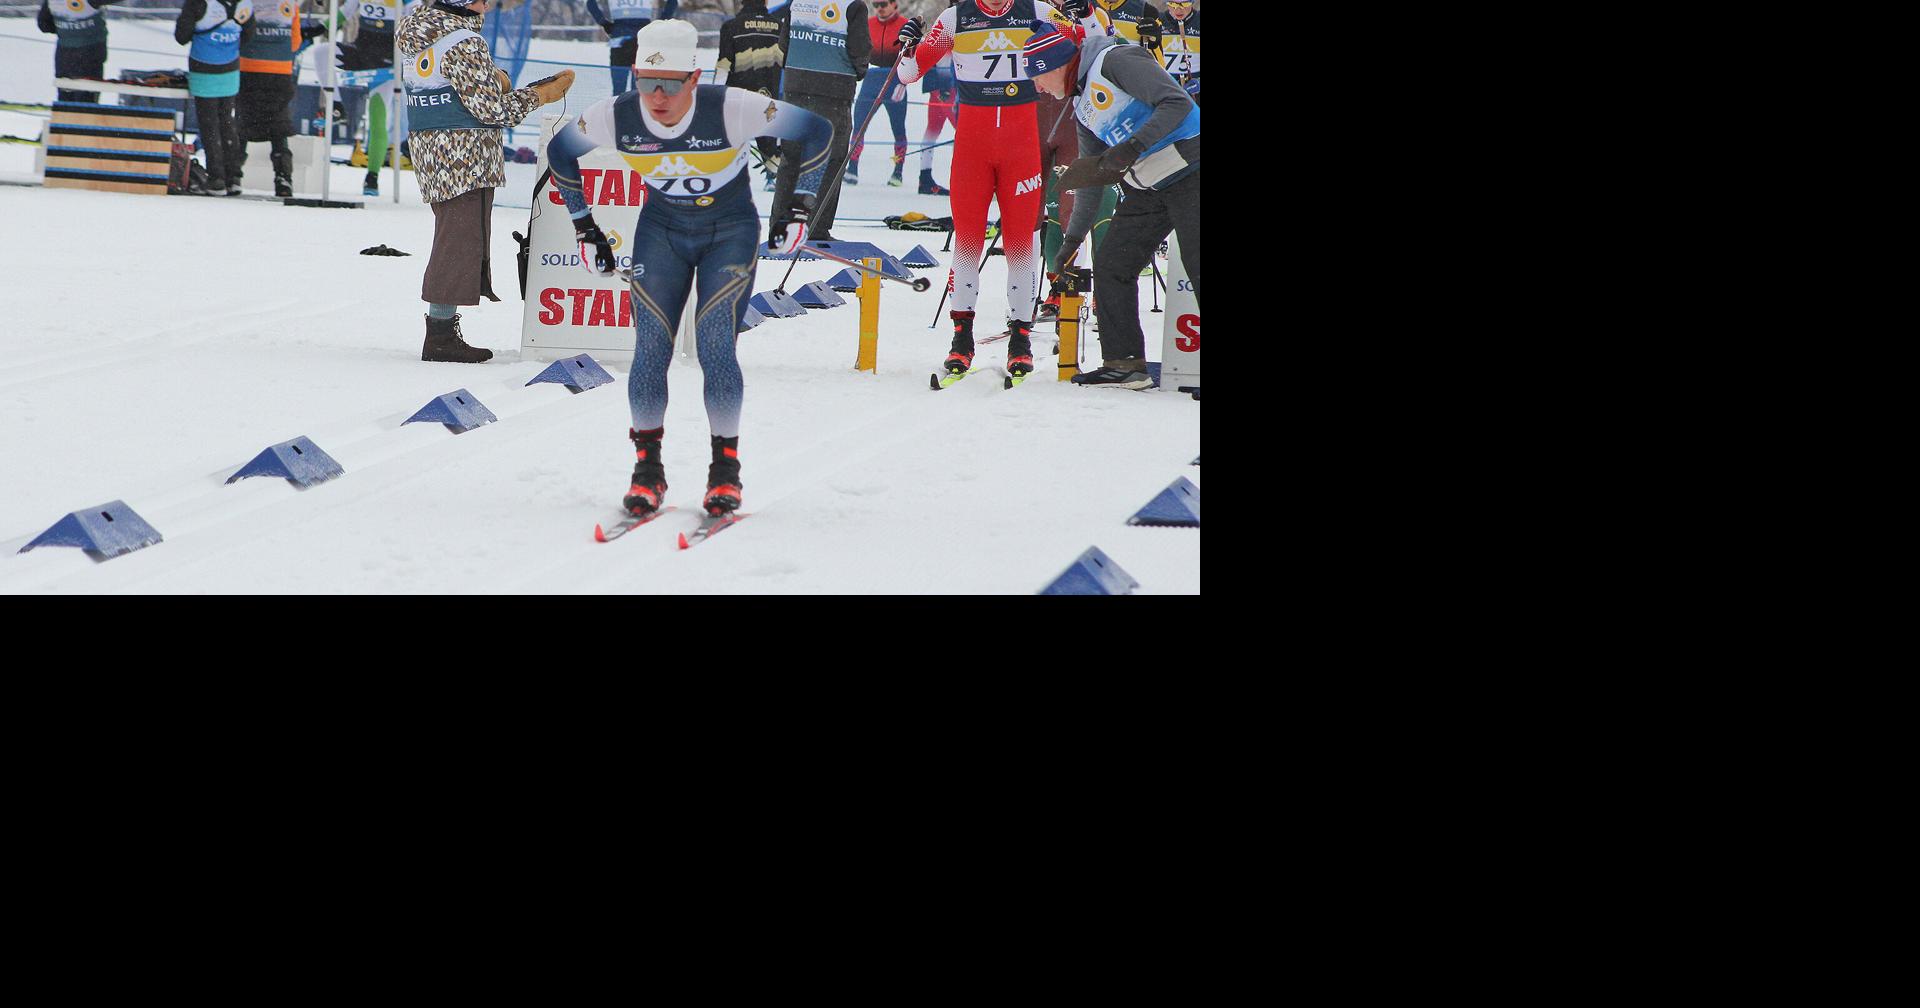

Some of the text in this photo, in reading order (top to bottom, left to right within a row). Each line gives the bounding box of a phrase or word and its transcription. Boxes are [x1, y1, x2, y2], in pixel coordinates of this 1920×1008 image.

[364, 4, 386, 18] 93
[744, 20, 779, 30] COLORADO
[982, 53, 1018, 80] 71
[1164, 53, 1193, 72] 75
[406, 93, 452, 107] NTEER
[702, 138, 723, 147] NNF
[652, 177, 712, 195] 70
